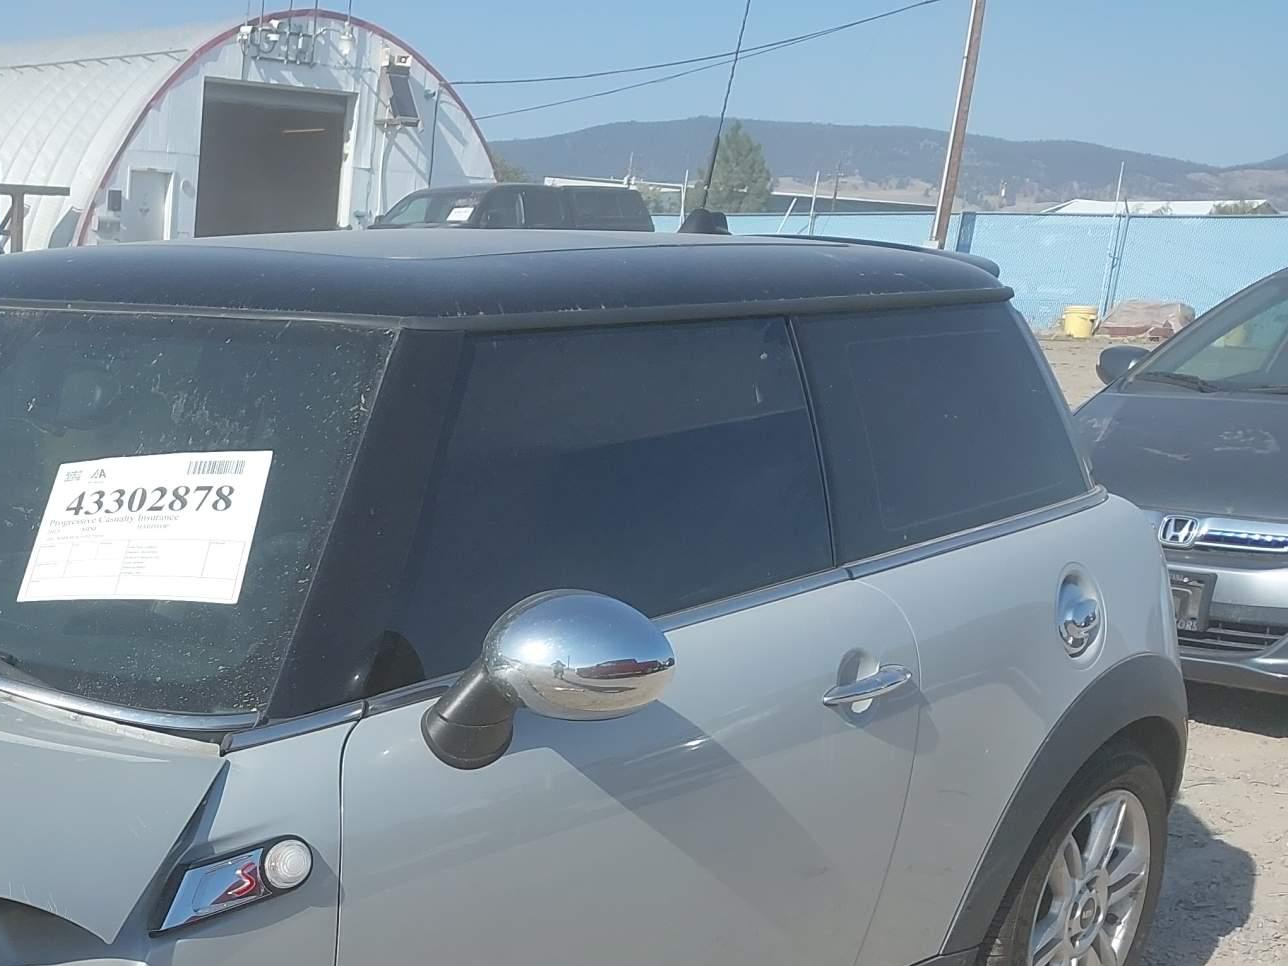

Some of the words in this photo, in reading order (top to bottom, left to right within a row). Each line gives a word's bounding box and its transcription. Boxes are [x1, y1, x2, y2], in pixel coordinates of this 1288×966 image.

[65, 485, 235, 516] 43302878
[50, 518, 97, 527] Progressive
[98, 514, 134, 524] Casualty
[137, 513, 180, 522] Insurance
[1176, 620, 1198, 631] ORS
